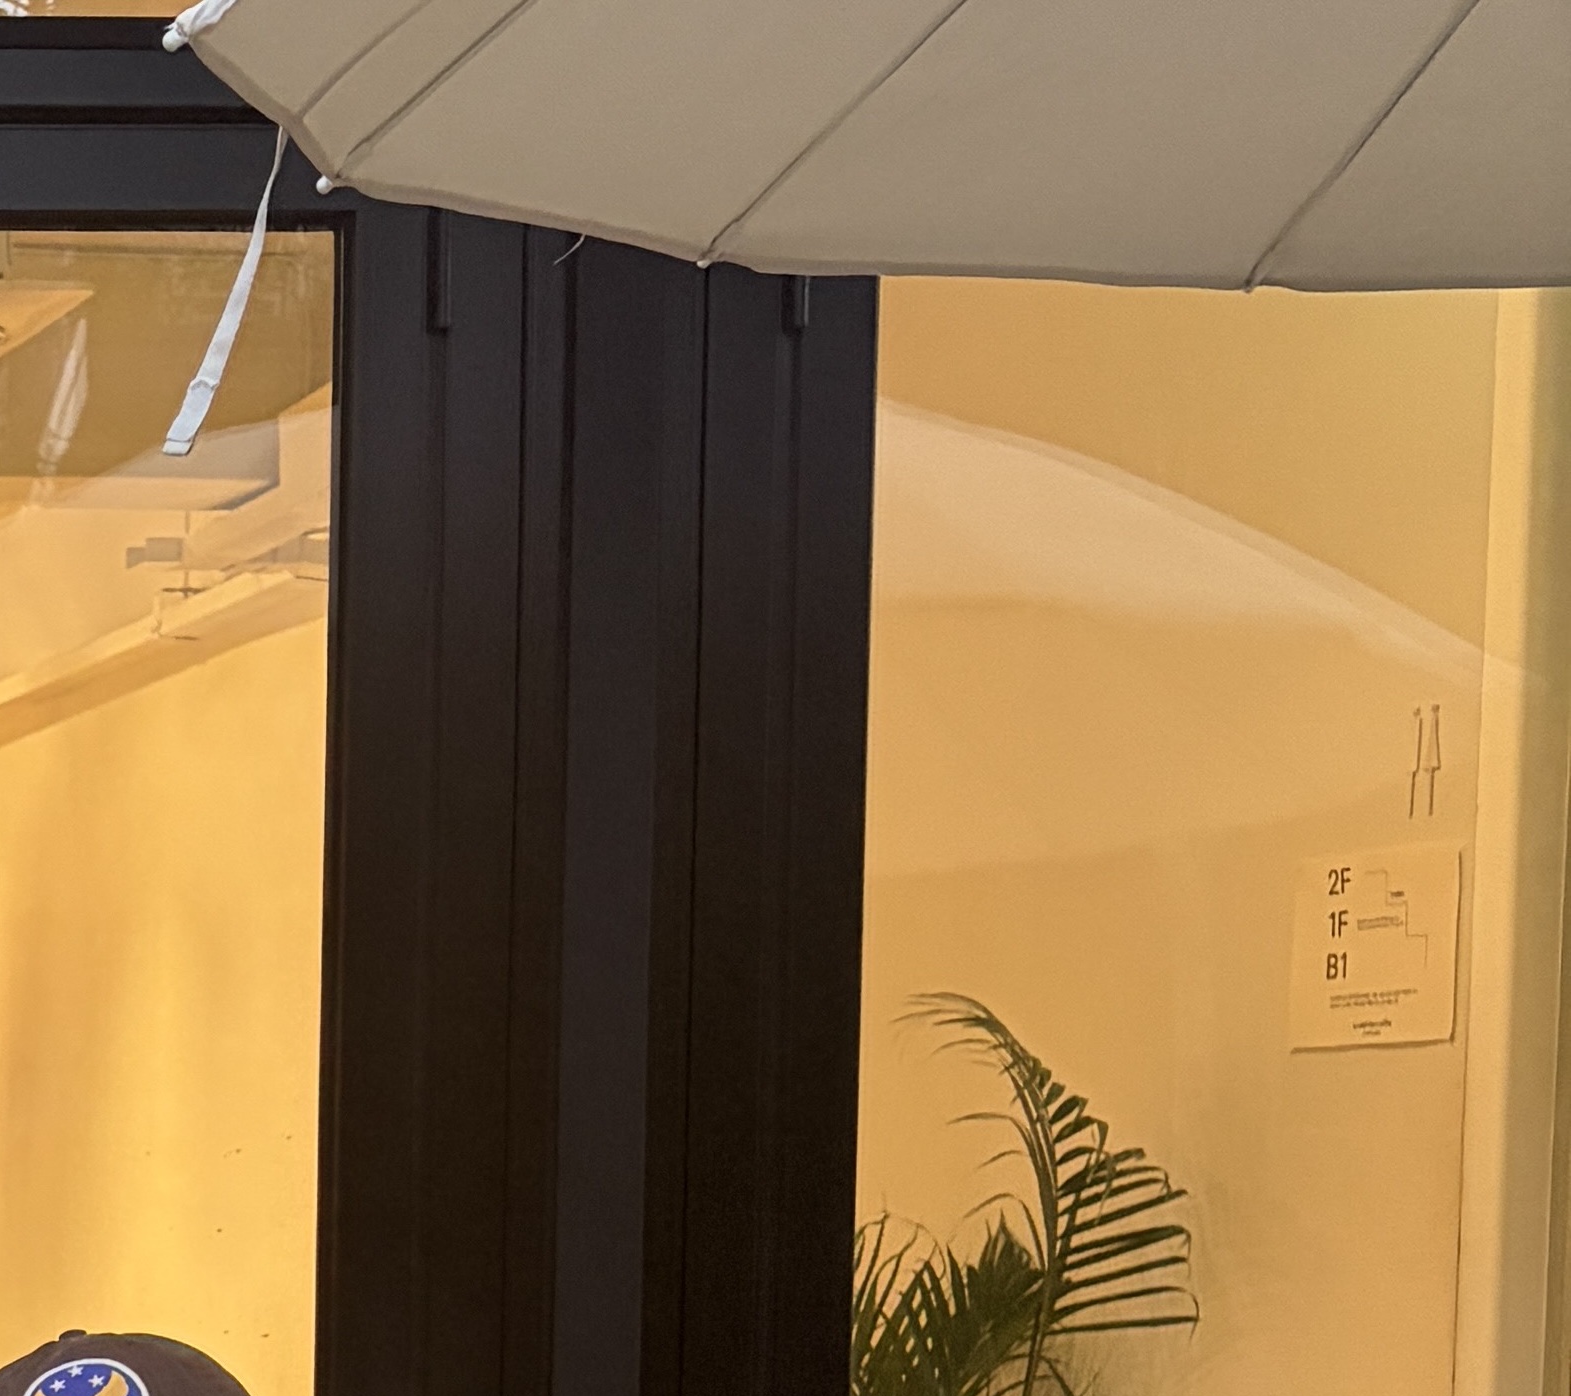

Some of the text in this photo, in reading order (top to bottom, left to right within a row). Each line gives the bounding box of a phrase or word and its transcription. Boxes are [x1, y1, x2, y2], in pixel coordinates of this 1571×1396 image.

[1328, 867, 1351, 895] 2F
[1328, 910, 1349, 938] 1F
[1326, 952, 1347, 980] B1
